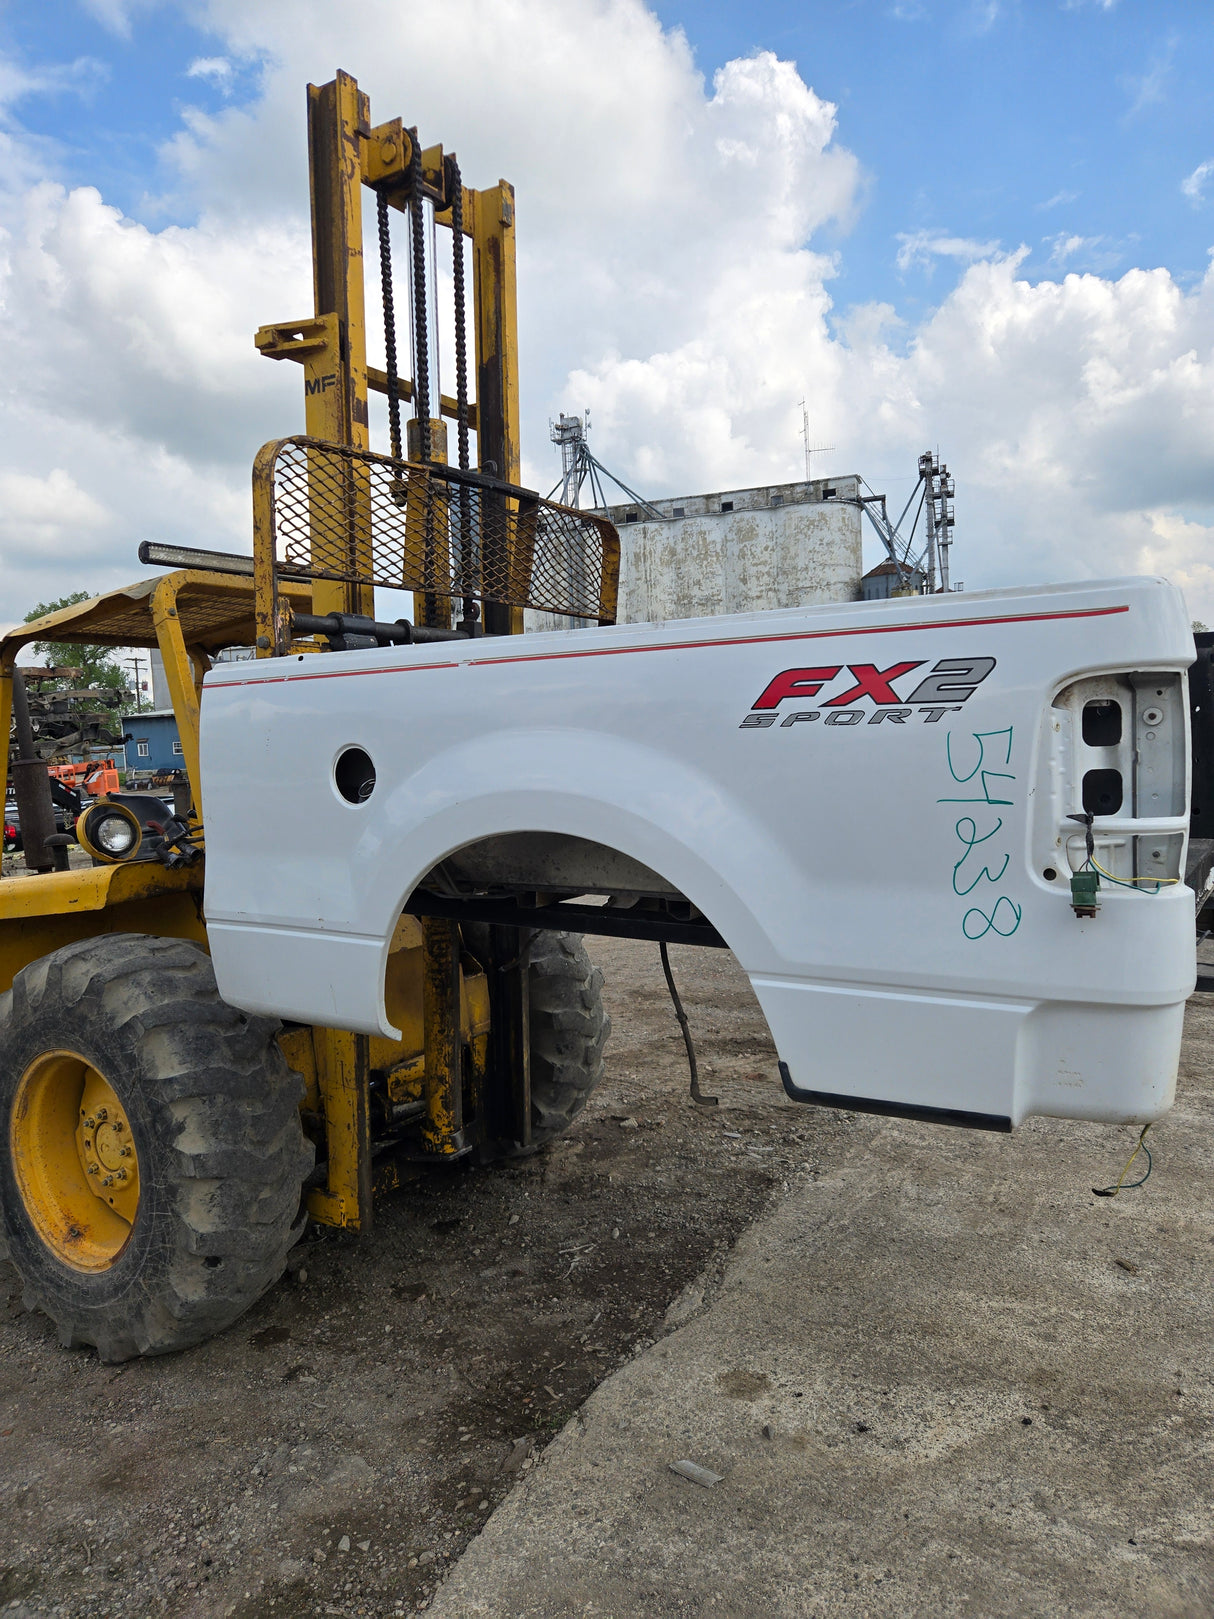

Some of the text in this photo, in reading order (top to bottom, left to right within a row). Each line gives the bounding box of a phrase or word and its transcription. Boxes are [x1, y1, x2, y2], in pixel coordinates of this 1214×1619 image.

[305, 373, 336, 396] MF
[750, 656, 997, 710] FX2
[738, 705, 963, 729] SPORT
[937, 725, 1022, 940] 54238
